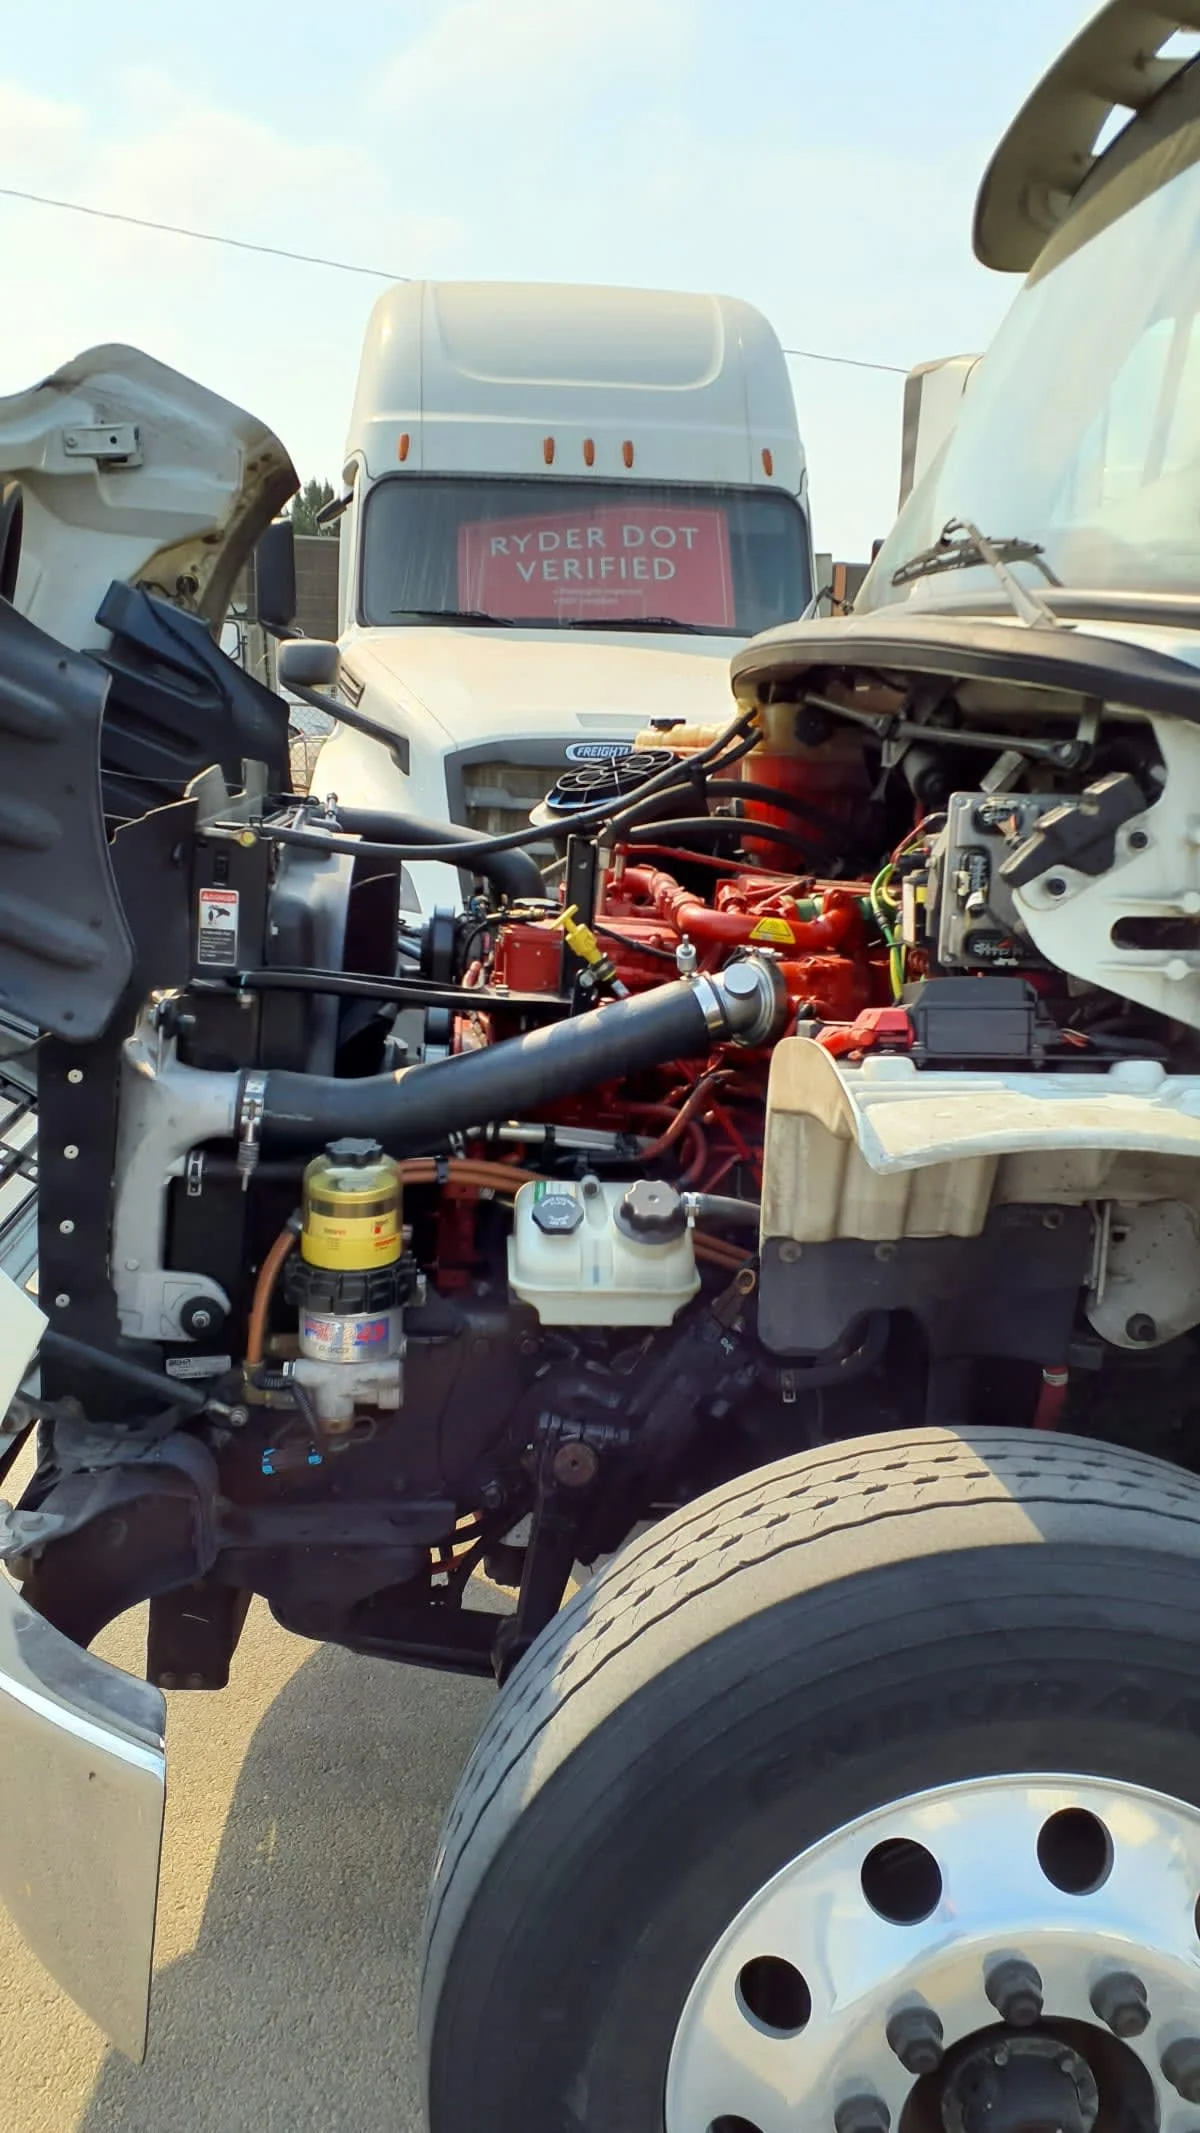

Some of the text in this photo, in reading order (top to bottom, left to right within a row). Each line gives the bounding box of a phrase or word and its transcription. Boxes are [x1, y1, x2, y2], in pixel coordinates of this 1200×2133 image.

[490, 525, 699, 557] RYDER DOT
[516, 557, 676, 582] VERIFIED
